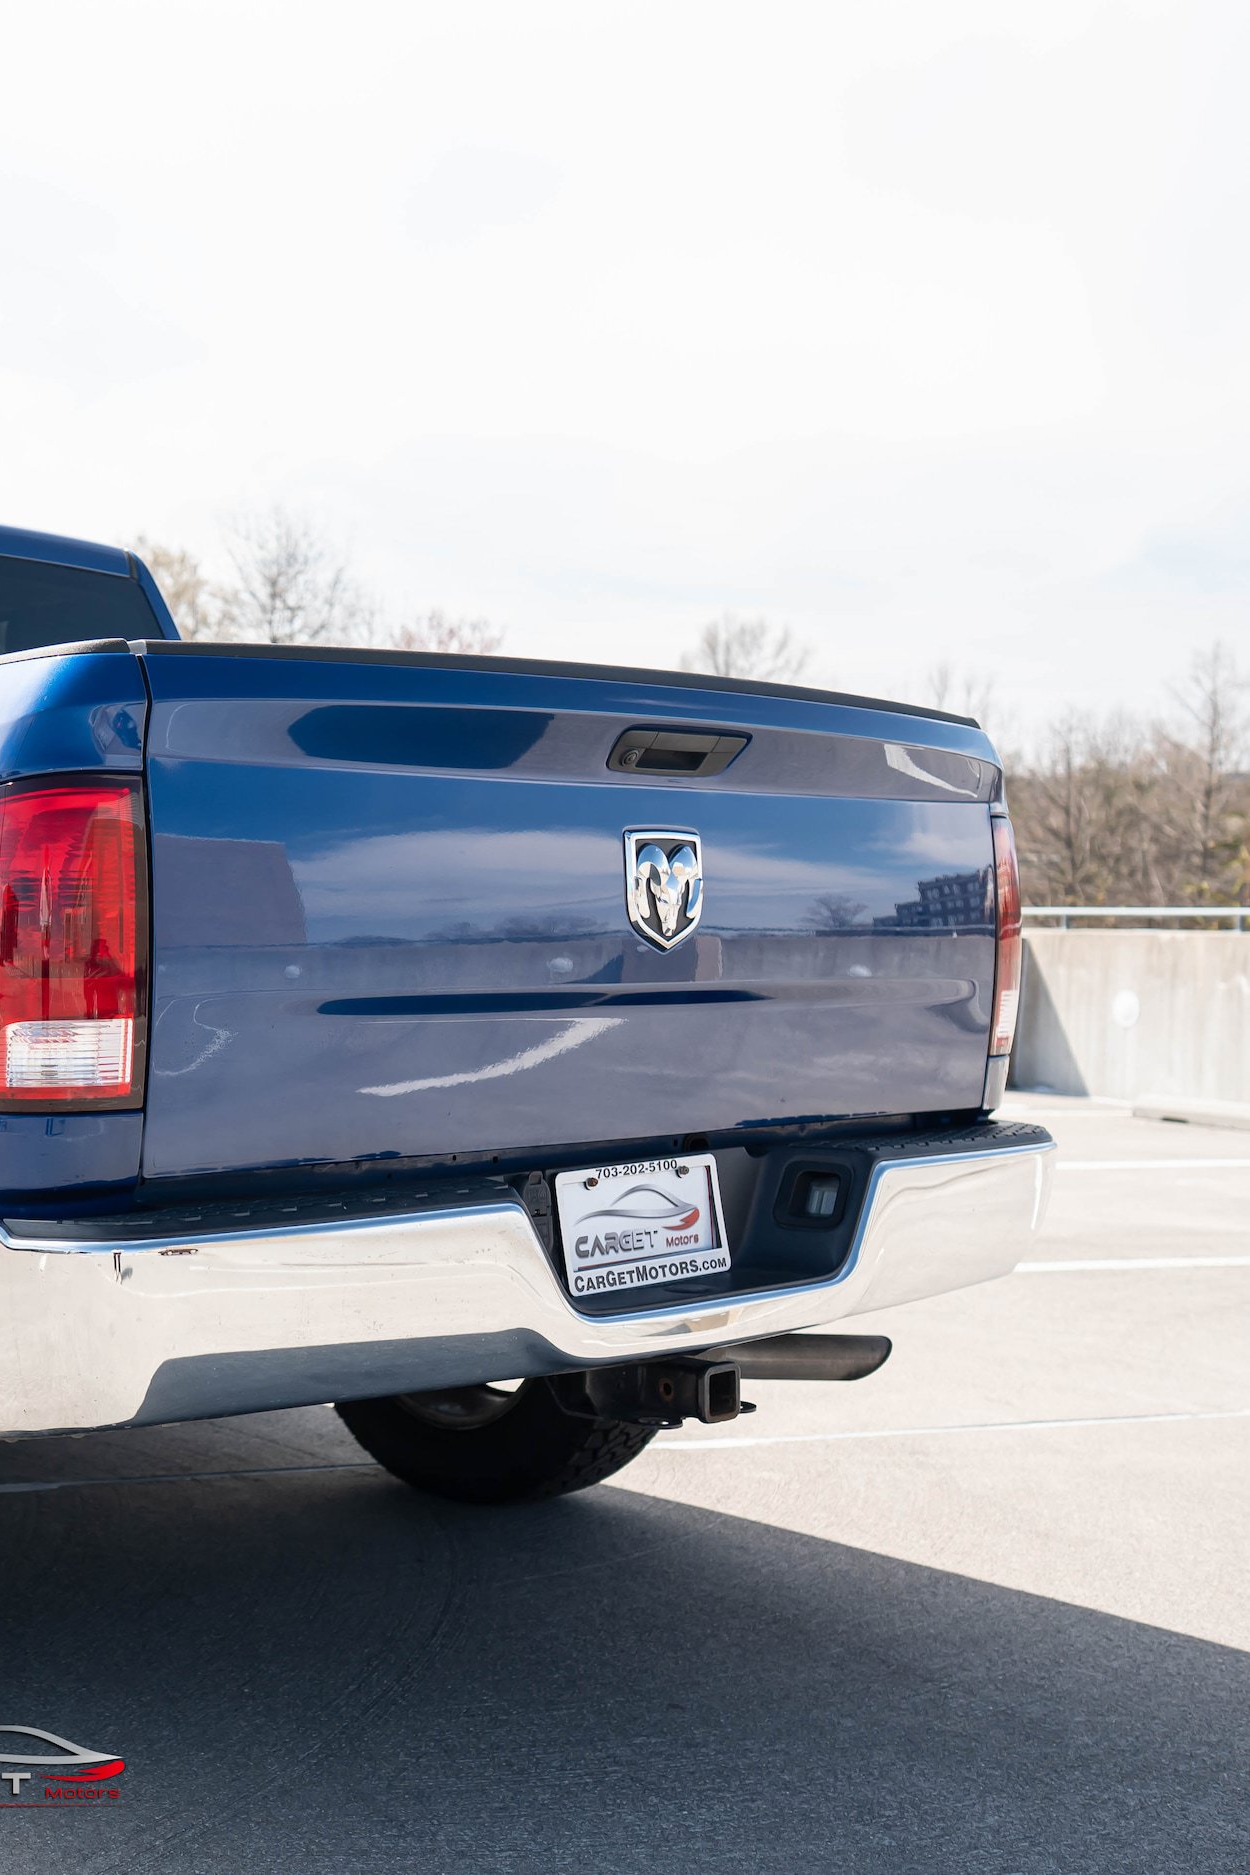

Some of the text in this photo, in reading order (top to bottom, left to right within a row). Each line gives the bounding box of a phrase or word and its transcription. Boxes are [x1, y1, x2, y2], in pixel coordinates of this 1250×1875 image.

[595, 1159, 678, 1180] 703-202-5100
[575, 1230, 699, 1259] CARGET Motors
